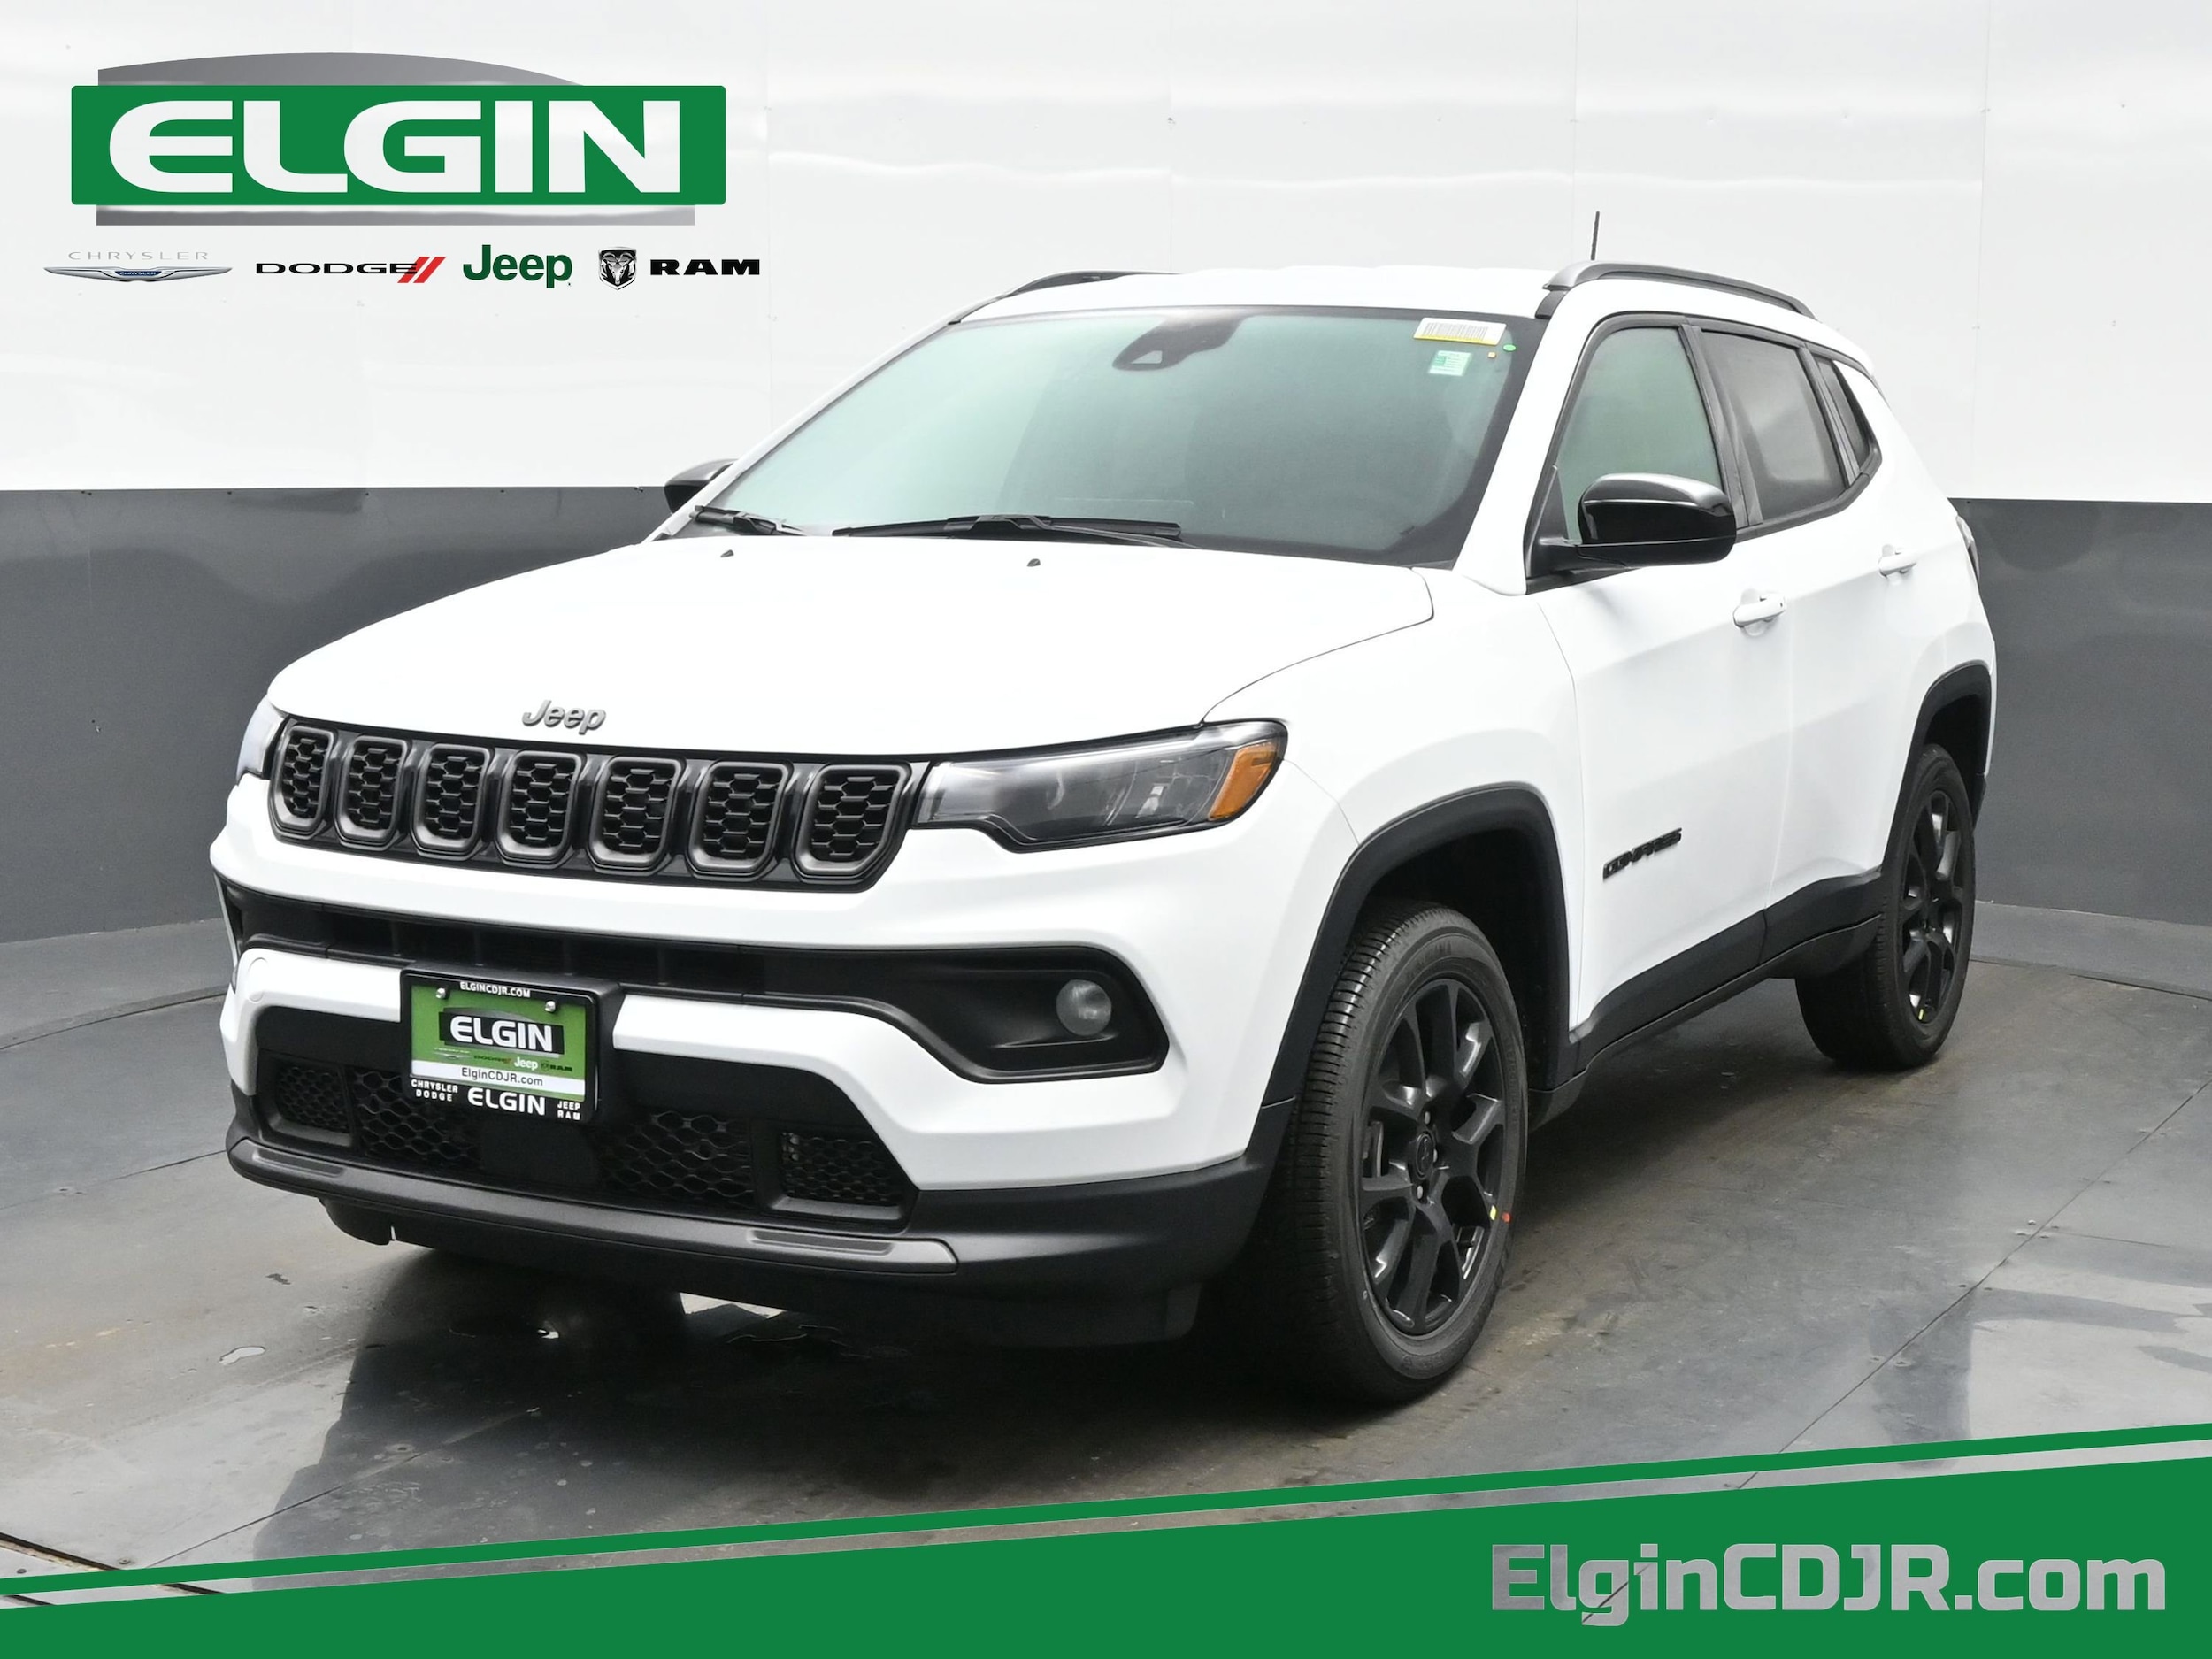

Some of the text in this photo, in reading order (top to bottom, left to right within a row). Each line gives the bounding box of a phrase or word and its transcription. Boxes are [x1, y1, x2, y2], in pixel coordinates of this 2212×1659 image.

[521, 699, 606, 735] Jeep
[459, 981, 531, 998] ELGINCDJR.COM
[449, 1016, 553, 1052] ELGIN
[514, 1057, 538, 1071] Jeep
[461, 1067, 543, 1087] ElginCDJR.com
[411, 1079, 458, 1094] CHRYSLER
[415, 1090, 453, 1102] DODGE
[467, 1087, 546, 1116] ELGIN
[557, 1101, 581, 1110] JEEP
[557, 1111, 581, 1121] RAM
